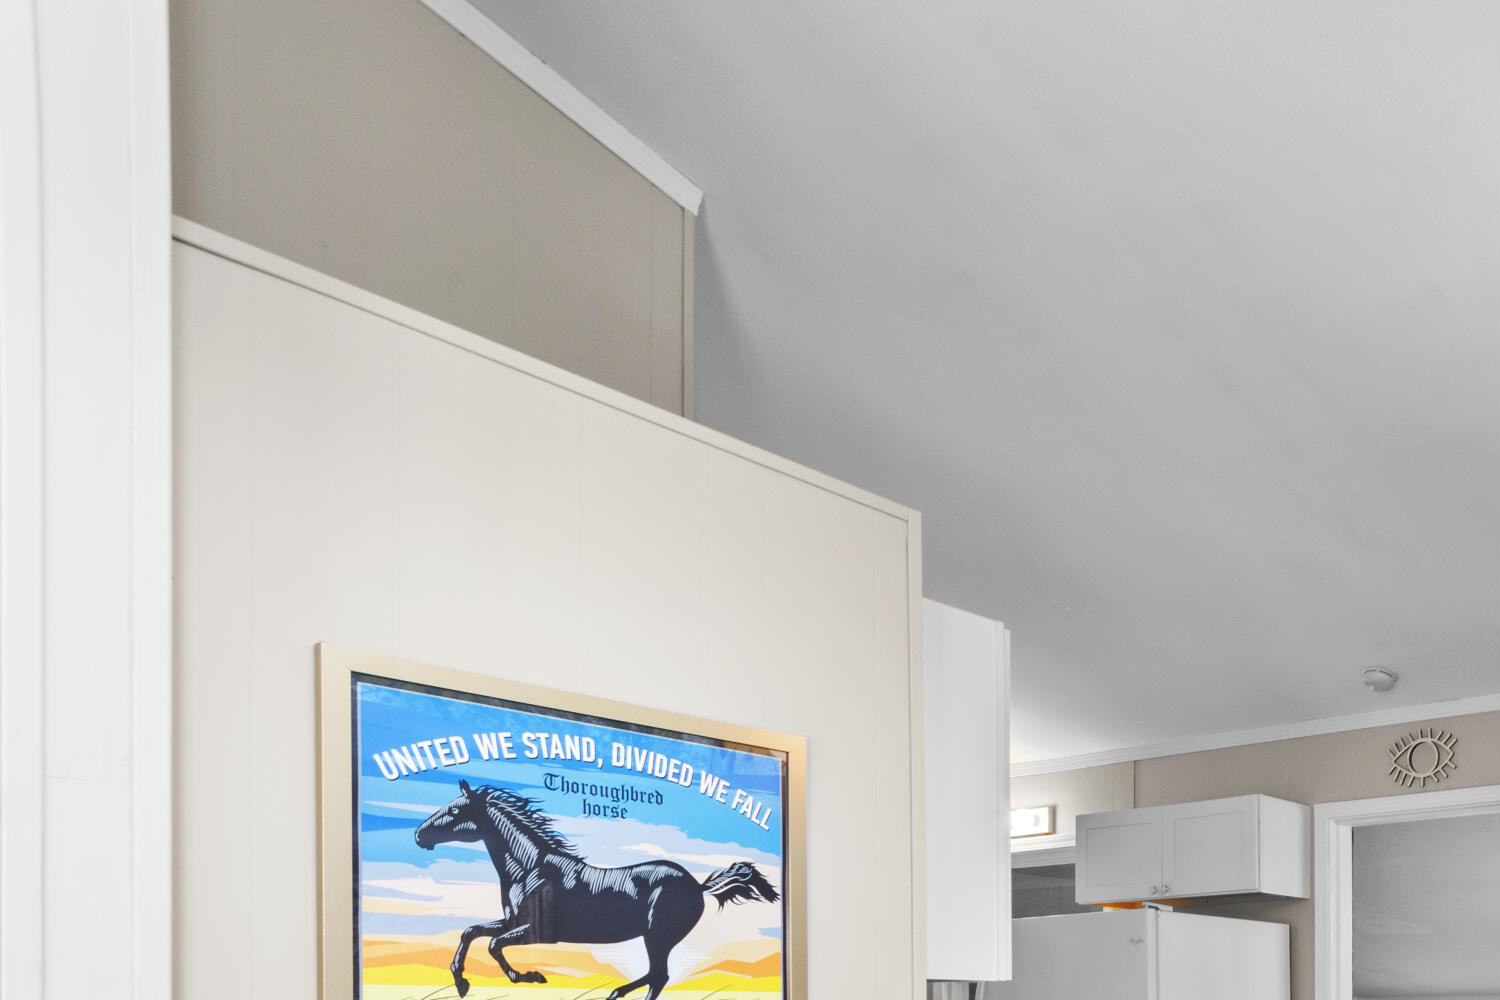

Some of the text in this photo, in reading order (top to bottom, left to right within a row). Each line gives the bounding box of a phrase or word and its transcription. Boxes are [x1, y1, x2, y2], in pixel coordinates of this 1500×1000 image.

[373, 731, 772, 831] UNITED WE STAND, DIVIDED WE FALL
[543, 772, 664, 806] Thoroughbred
[582, 798, 628, 819] horse
